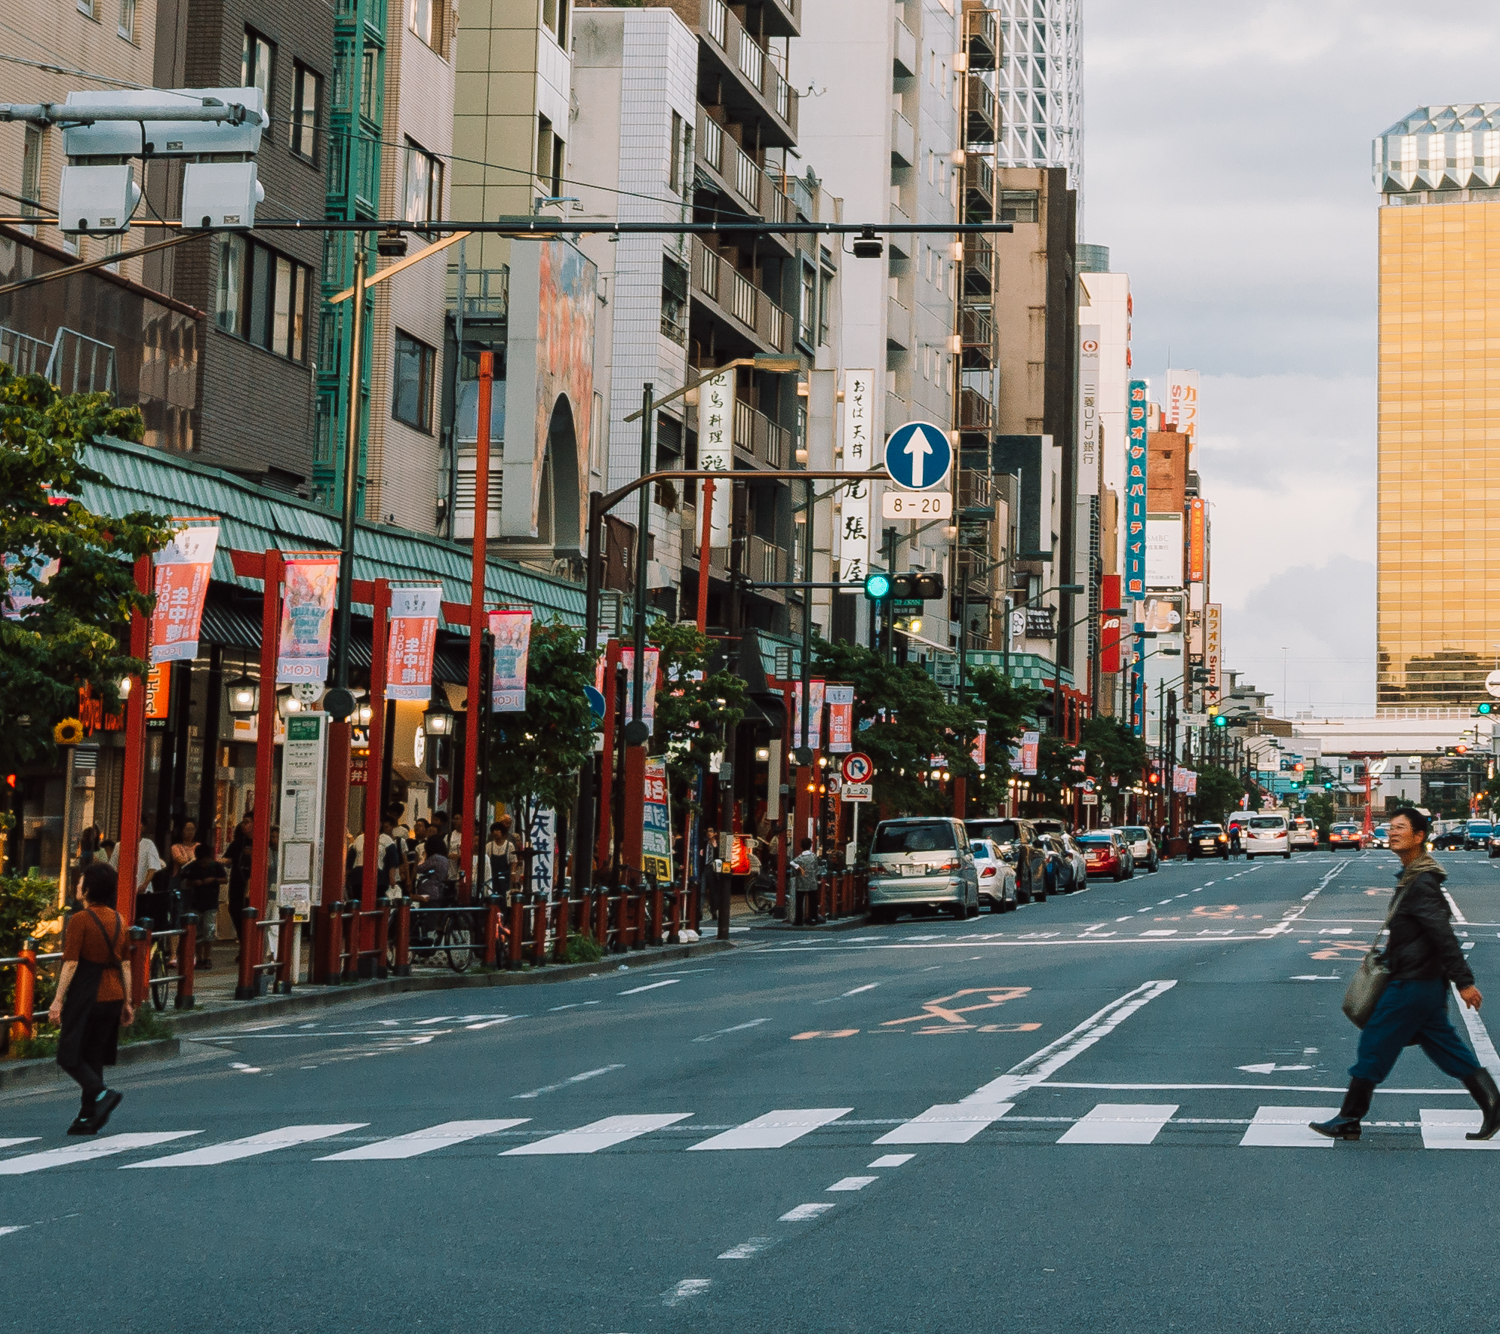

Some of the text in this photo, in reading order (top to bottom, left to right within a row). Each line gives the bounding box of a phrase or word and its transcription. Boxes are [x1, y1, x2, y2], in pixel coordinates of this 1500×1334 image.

[1082, 384, 1096, 465] 三菱UFJ銀行
[893, 498, 941, 513] 8-20
[1103, 618, 1119, 630] JTB
[1207, 607, 1219, 653] カラオケ
